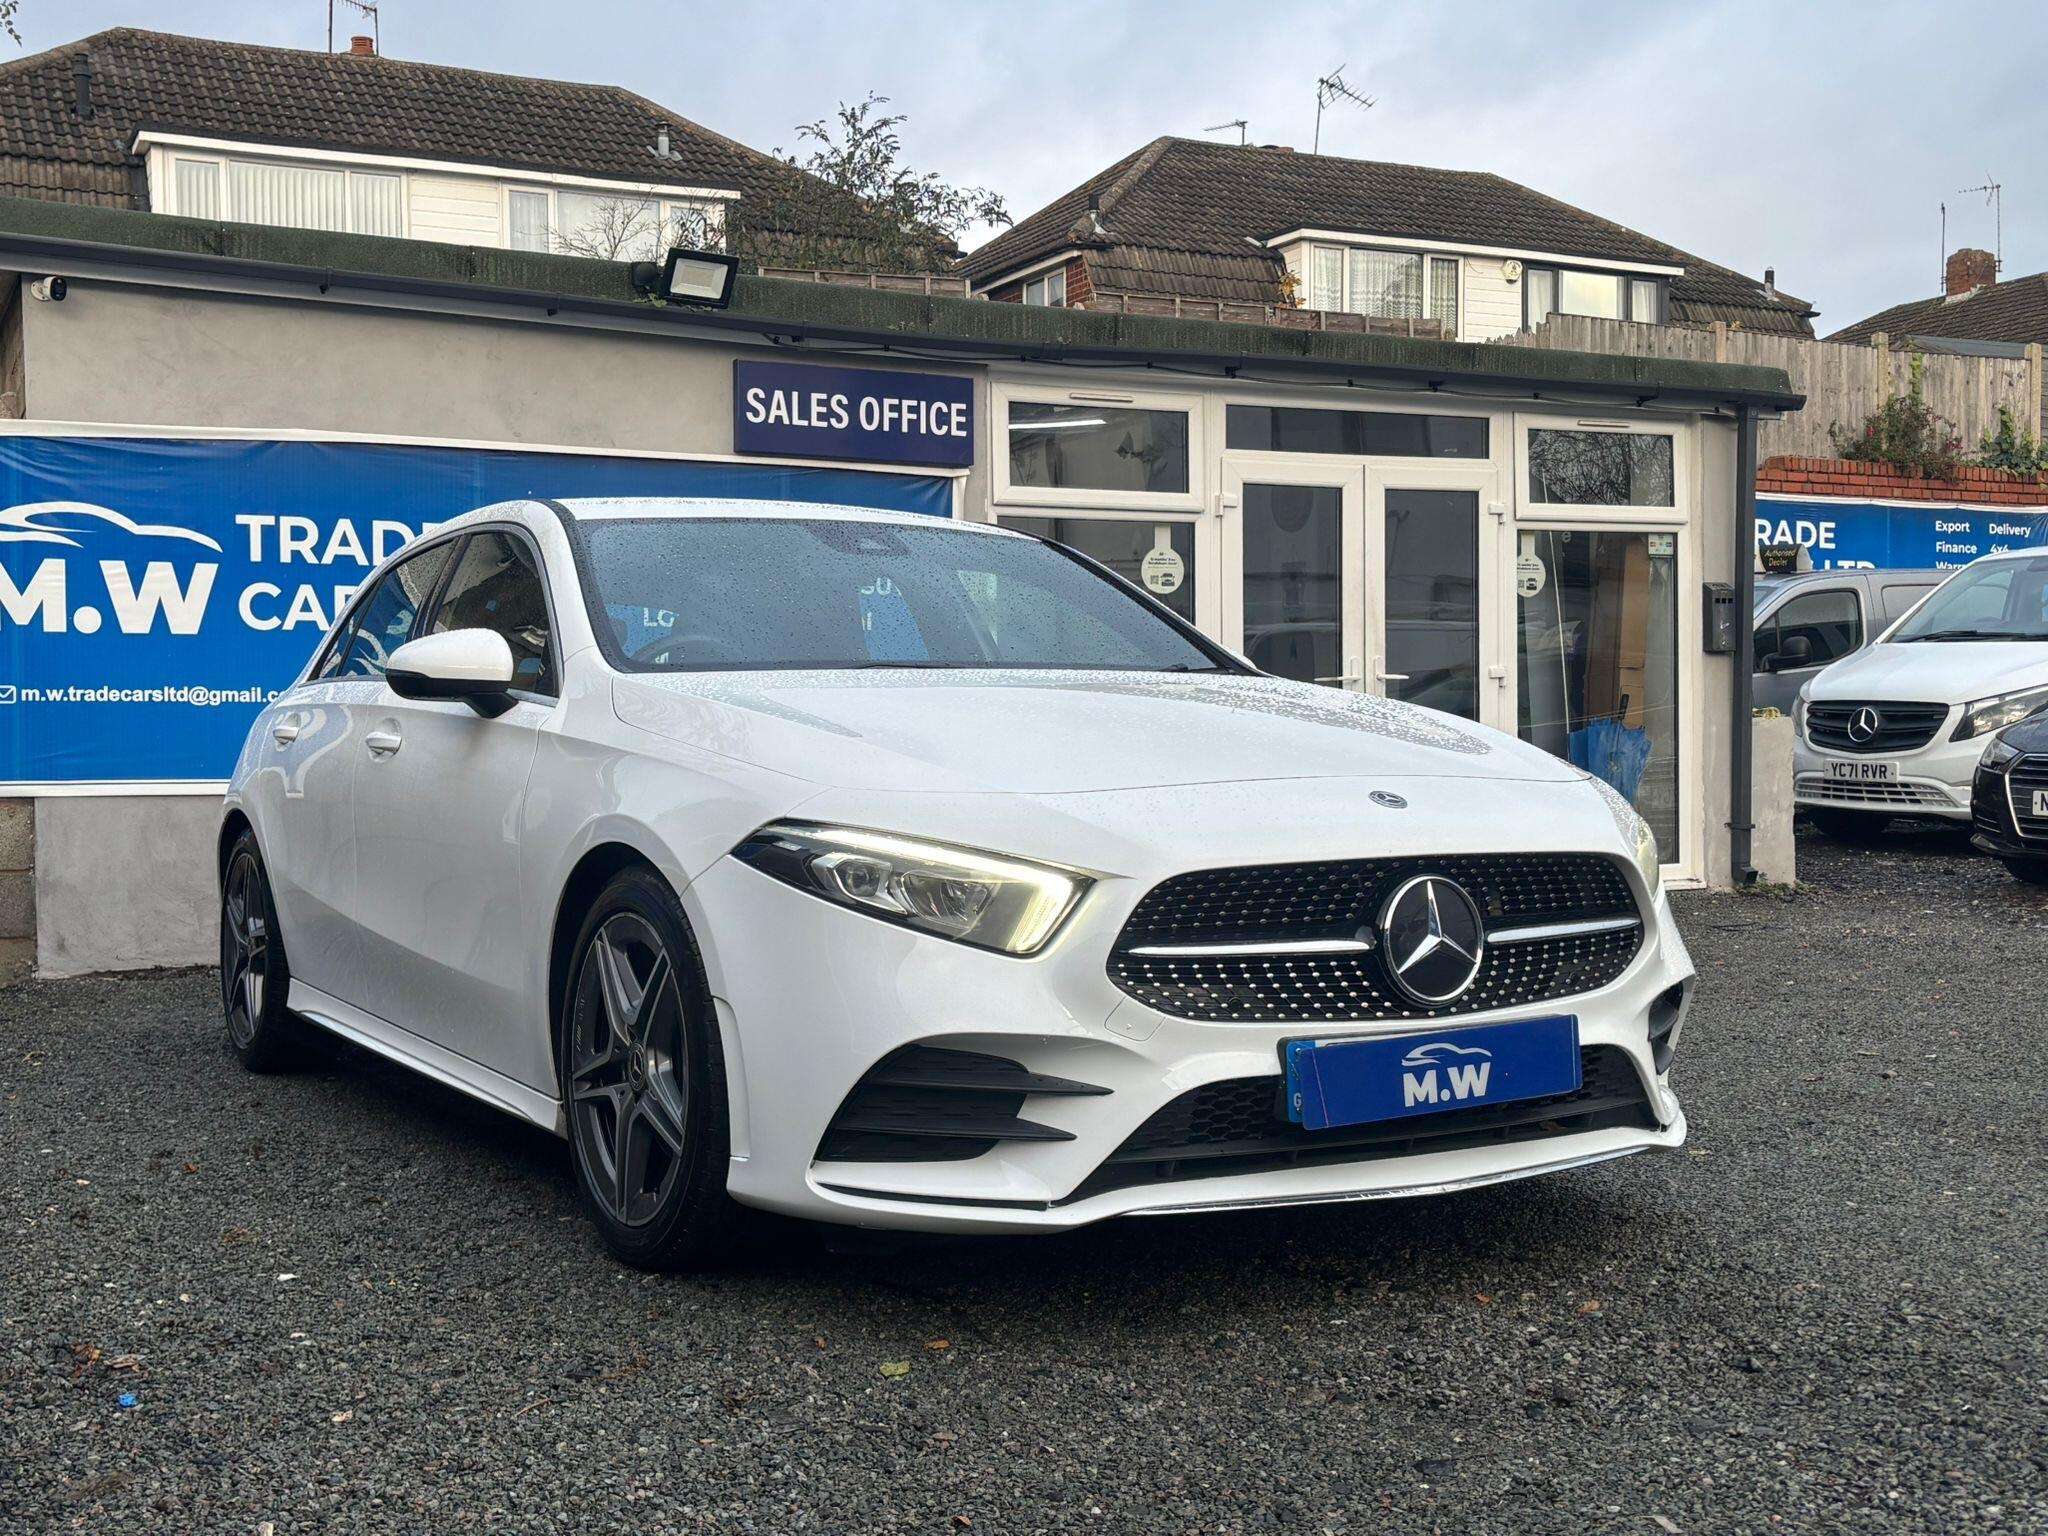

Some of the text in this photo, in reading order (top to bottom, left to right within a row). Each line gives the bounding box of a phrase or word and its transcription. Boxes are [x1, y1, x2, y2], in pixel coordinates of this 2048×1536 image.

[745, 387, 968, 438] SALES OFFICE
[235, 514, 442, 566] TRAD
[1754, 518, 1836, 549] RADE
[1935, 520, 2031, 538] Export Delivery
[1935, 541, 1978, 554] Finance
[0, 558, 219, 635] M.W
[1831, 762, 1887, 780] YC71 RVR
[1403, 1062, 1491, 1107] M.W
